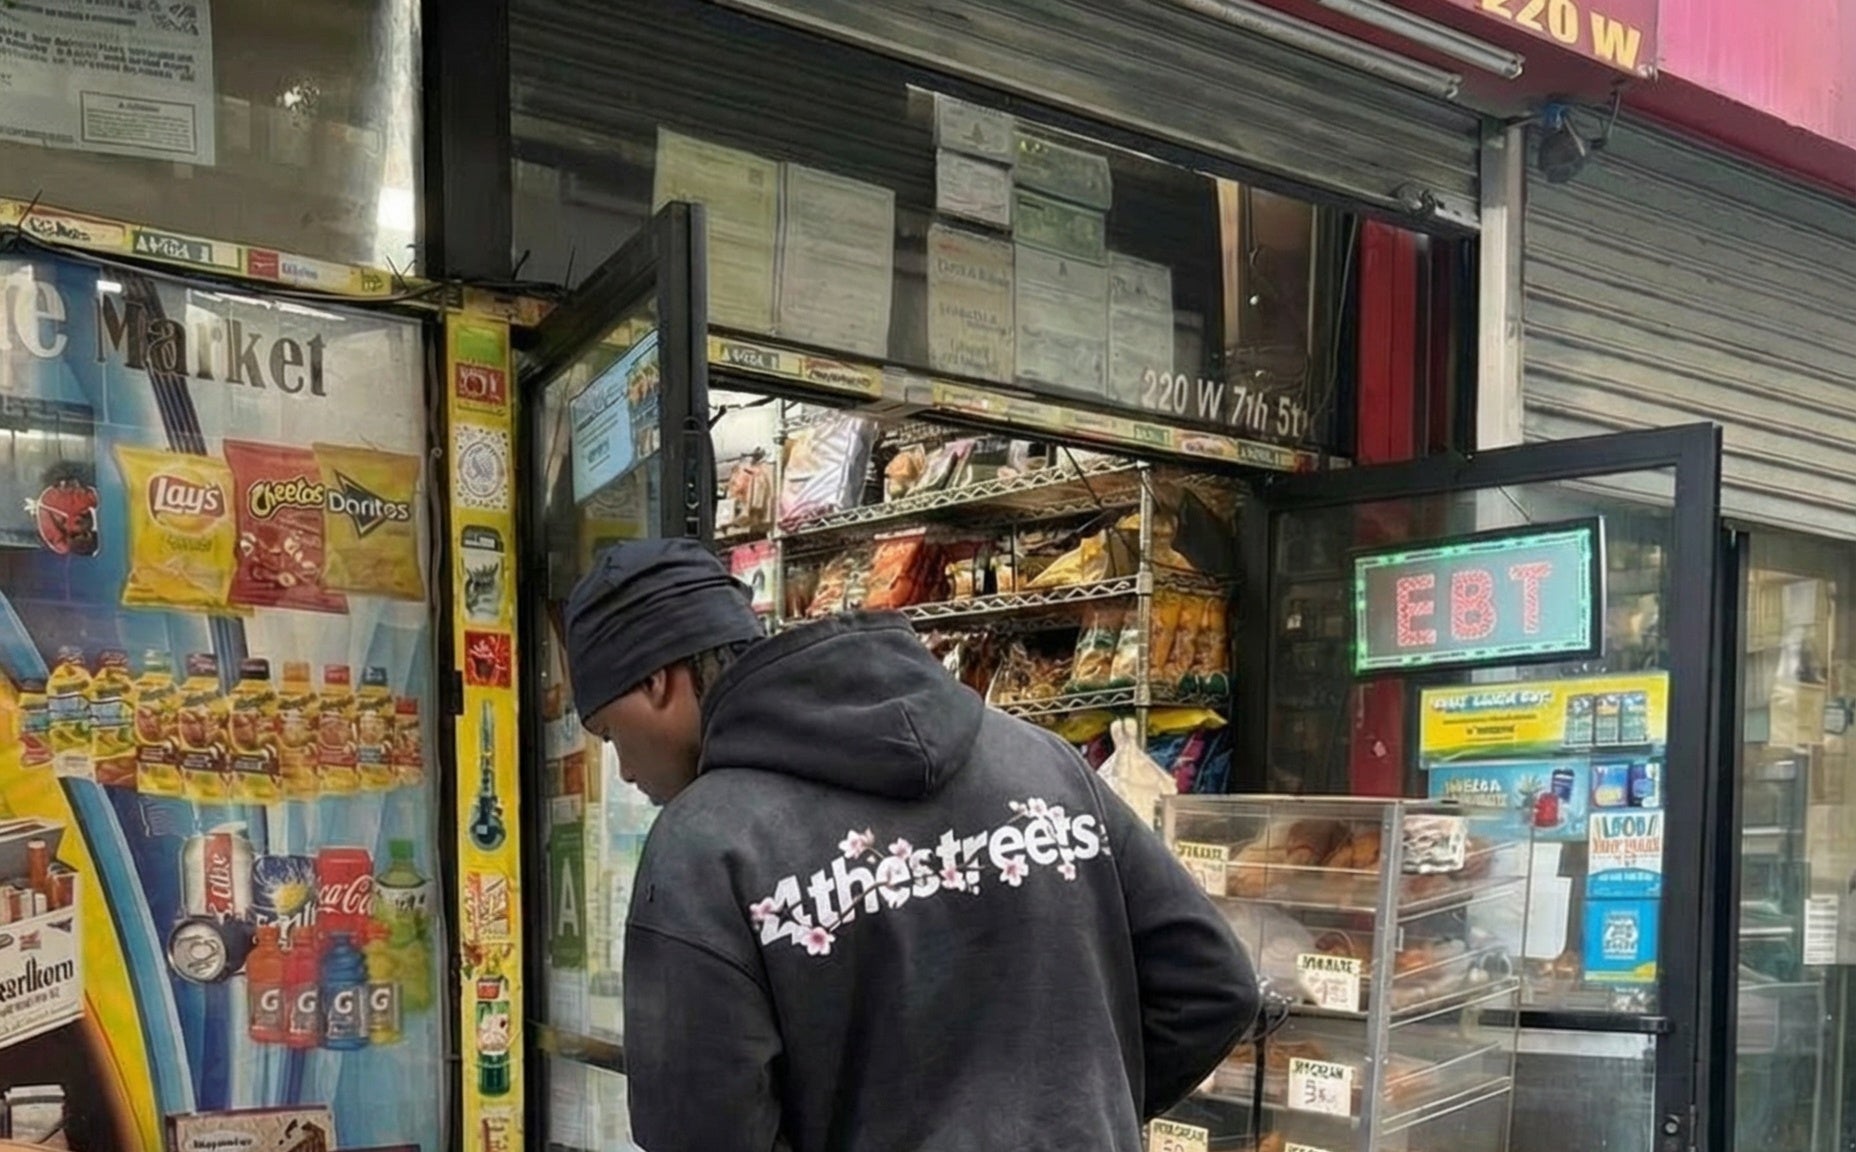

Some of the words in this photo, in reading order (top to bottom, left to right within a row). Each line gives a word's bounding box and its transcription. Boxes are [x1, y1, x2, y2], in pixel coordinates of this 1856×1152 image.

[1590, 11, 1641, 70] W
[95, 293, 327, 397] Market
[1142, 370, 1189, 414] 220
[1198, 379, 1224, 421] W
[250, 477, 325, 518] Cheetos
[327, 490, 411, 520] Doritos
[1396, 562, 1551, 647] EBT
[557, 857, 580, 938] A
[261, 989, 280, 1012] G
[299, 990, 318, 1014] G
[334, 990, 354, 1014] G
[371, 987, 391, 1010] G
